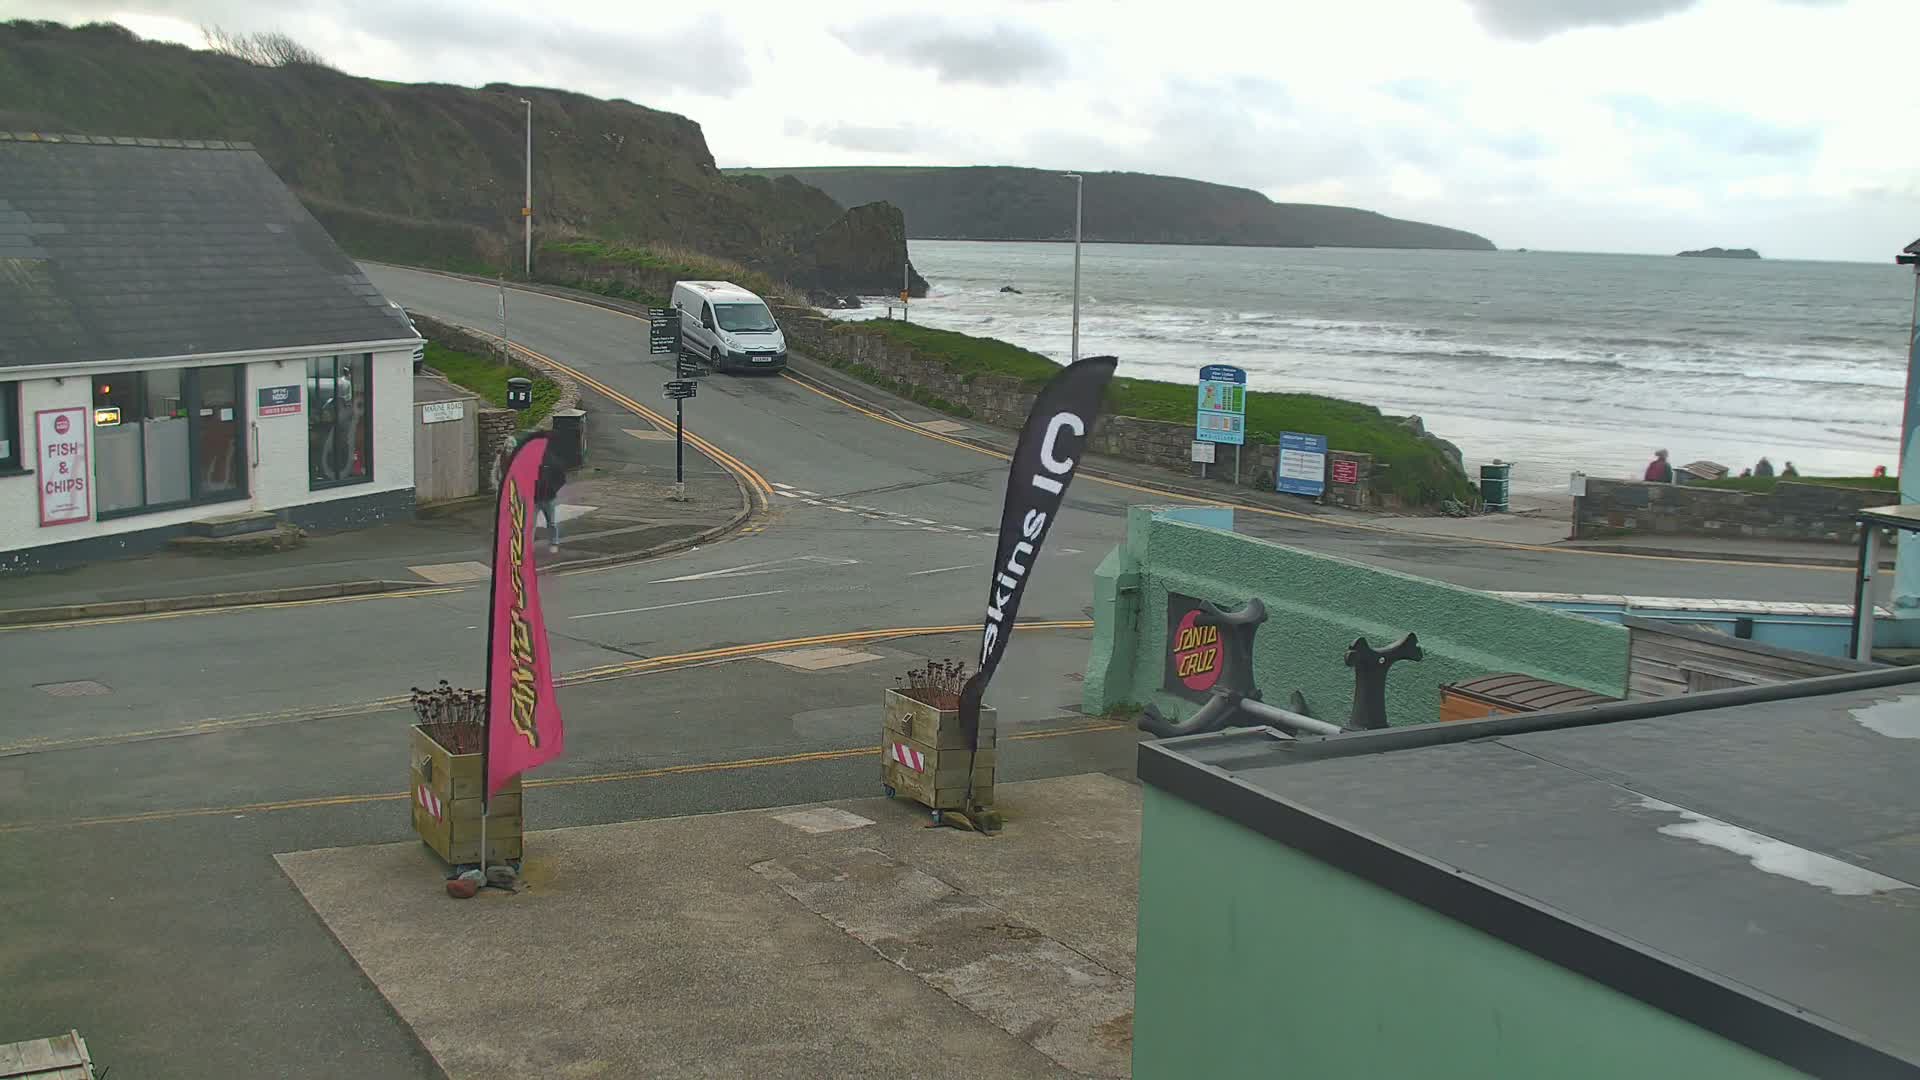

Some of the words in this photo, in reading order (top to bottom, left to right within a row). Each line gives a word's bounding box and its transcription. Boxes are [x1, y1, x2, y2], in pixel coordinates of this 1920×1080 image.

[48, 442, 78, 458] FISH
[59, 461, 69, 474] &
[45, 478, 84, 494] CHIPS
[1174, 625, 1217, 652] SANTA
[1179, 648, 1217, 677] CRUZ
